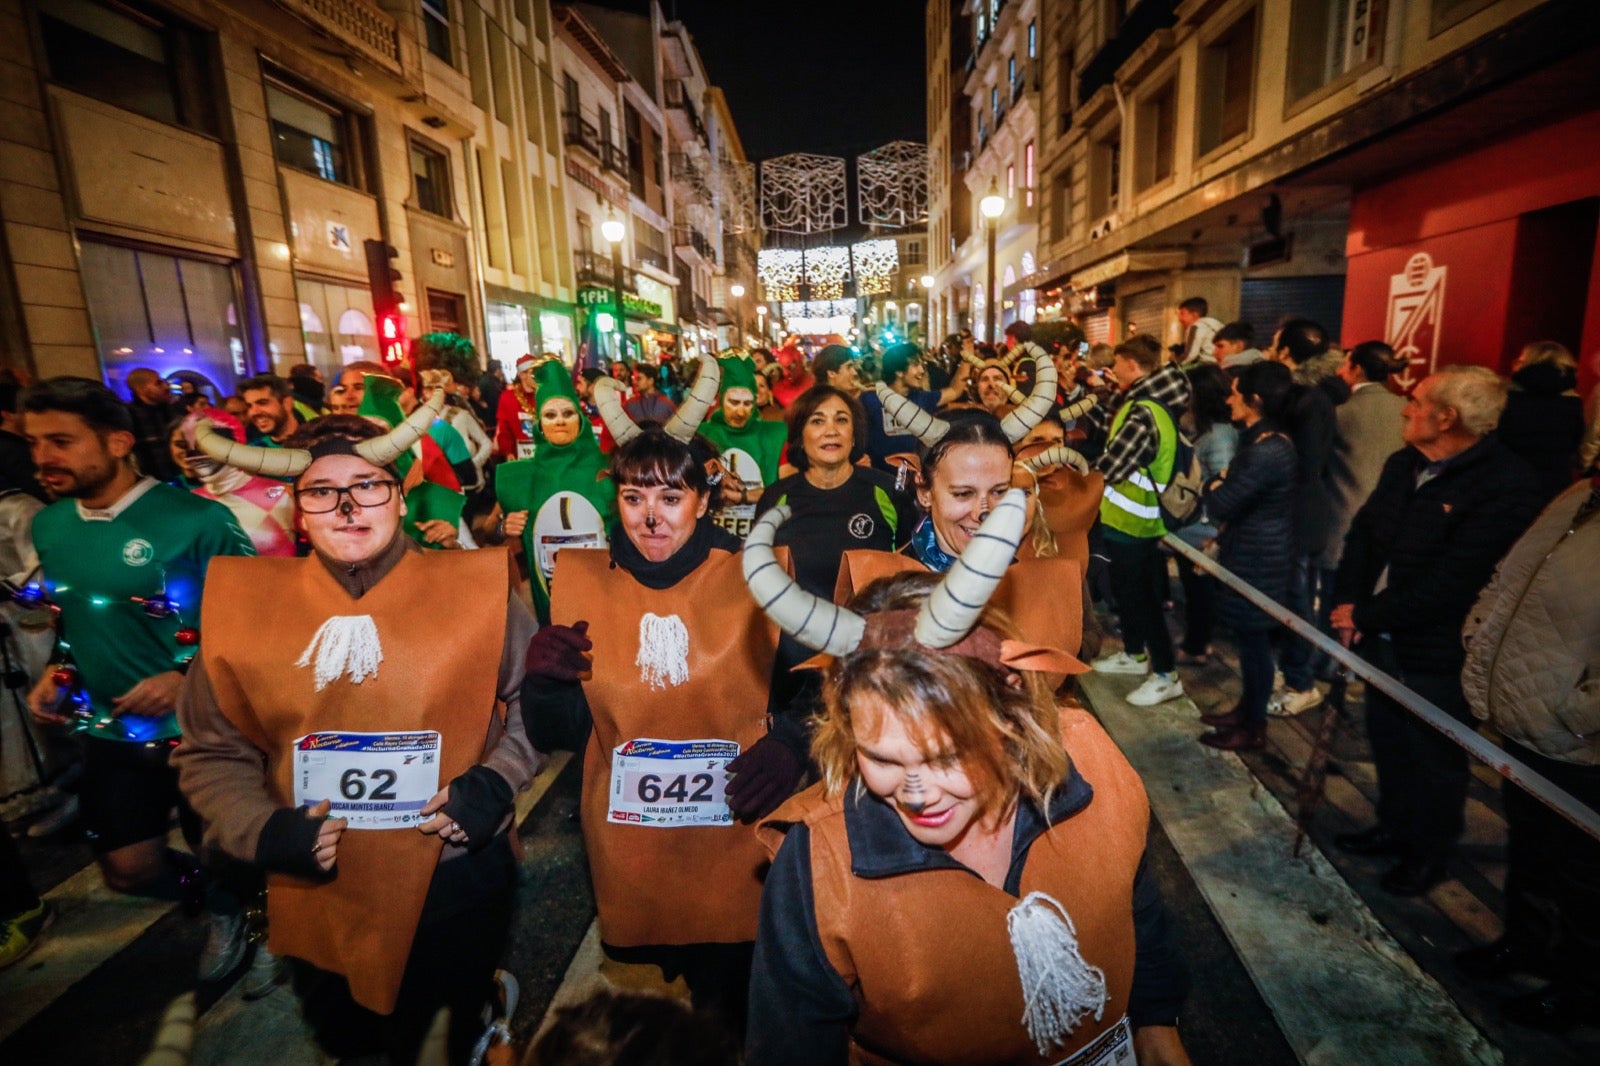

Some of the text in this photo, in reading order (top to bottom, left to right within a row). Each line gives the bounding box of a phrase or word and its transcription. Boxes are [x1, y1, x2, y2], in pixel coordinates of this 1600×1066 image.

[340, 768, 397, 800] 62
[638, 773, 714, 803] 642
[351, 803, 373, 811] MONTES
[660, 806, 677, 814] IBAÑEZ
